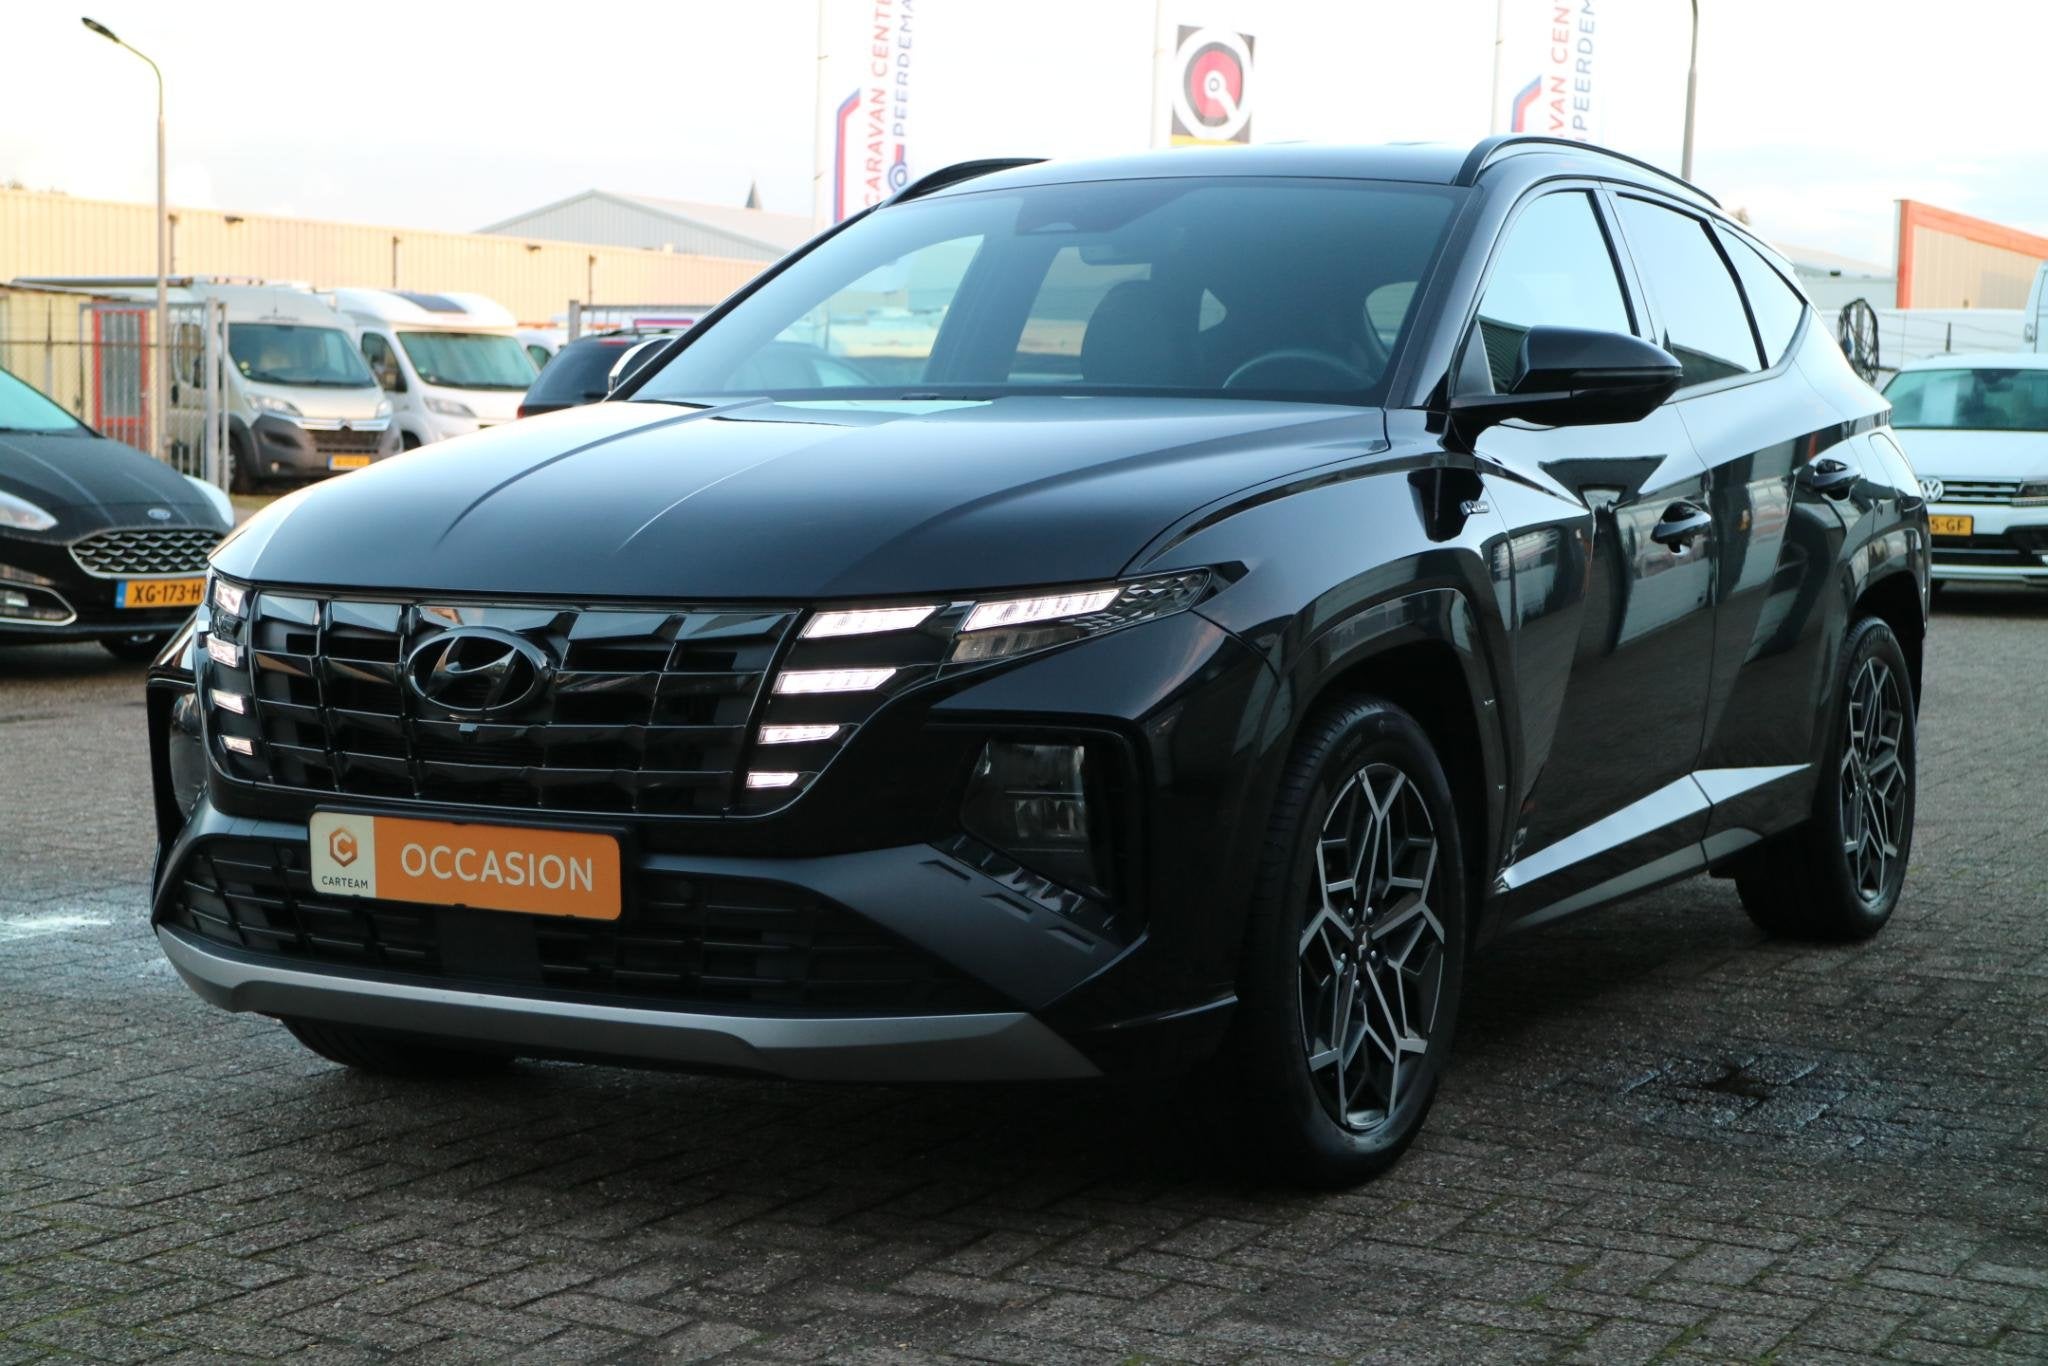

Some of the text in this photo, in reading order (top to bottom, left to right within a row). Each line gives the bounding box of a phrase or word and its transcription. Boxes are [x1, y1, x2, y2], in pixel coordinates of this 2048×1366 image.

[1549, 0, 1571, 137] VAN CEN
[864, 0, 892, 206] CARAVAN CENT
[134, 583, 202, 604] XG-173-H
[321, 875, 369, 889] CARTEAM
[400, 843, 594, 893] OCCASION
